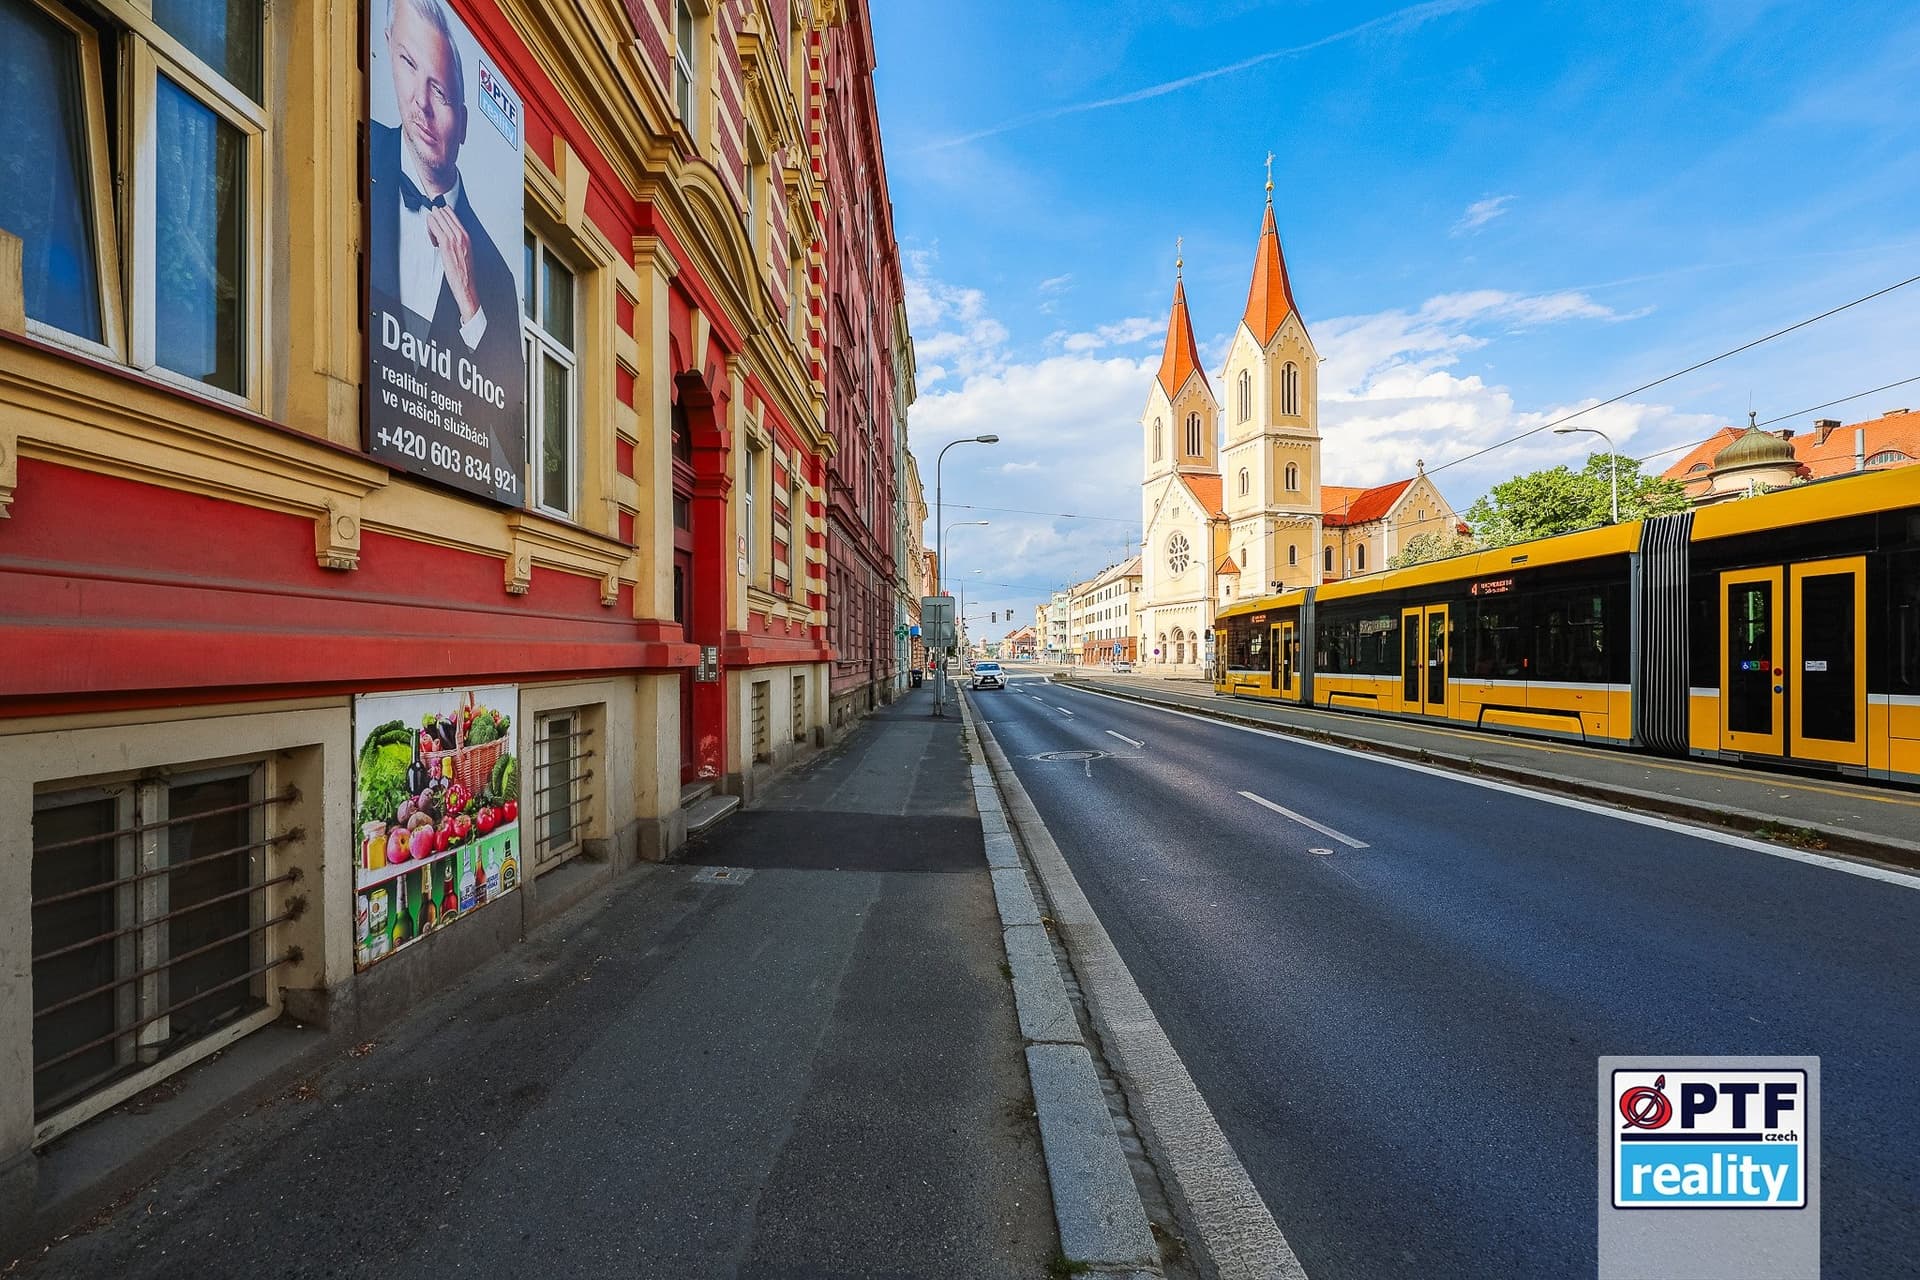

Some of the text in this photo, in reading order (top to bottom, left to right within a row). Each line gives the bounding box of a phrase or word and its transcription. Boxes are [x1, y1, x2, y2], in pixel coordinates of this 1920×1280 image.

[493, 82, 515, 119] PTF
[382, 311, 505, 409] David Choc
[382, 365, 463, 416] realitní agent
[382, 389, 489, 448] ve vašich službách
[377, 426, 517, 494] +420 603 834 921
